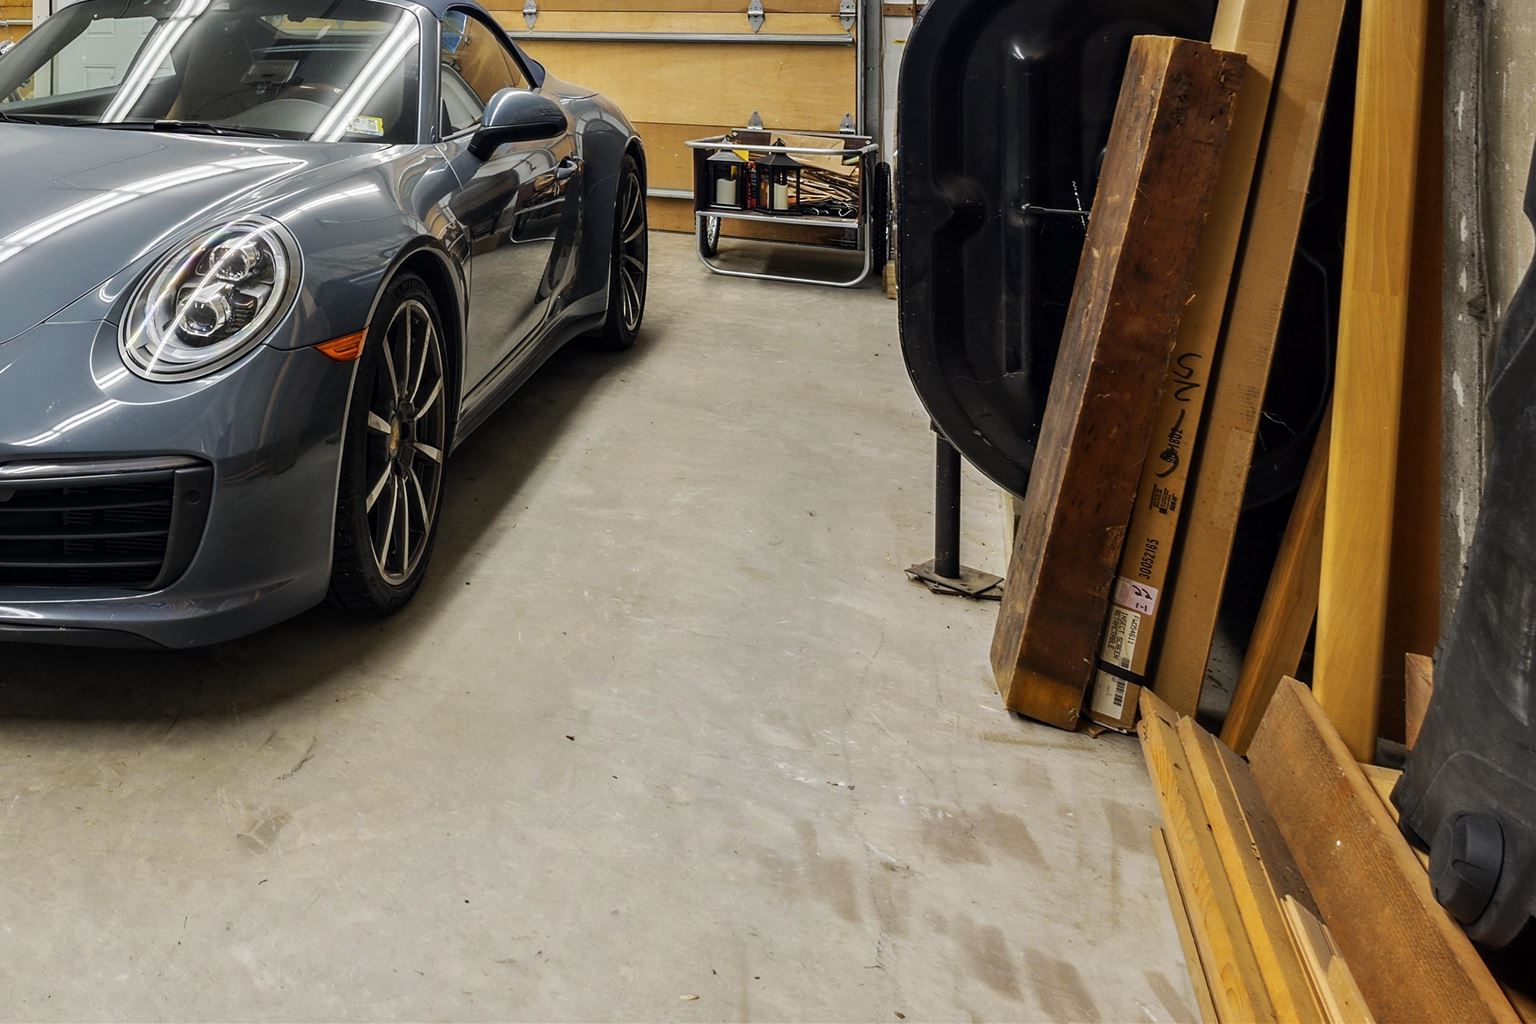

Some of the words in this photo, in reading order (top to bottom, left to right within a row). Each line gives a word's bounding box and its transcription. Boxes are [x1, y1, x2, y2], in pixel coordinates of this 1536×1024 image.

[1138, 537, 1159, 580] 30052165
[1117, 611, 1128, 635] INSECT
[1114, 636, 1124, 660] SCREEN
